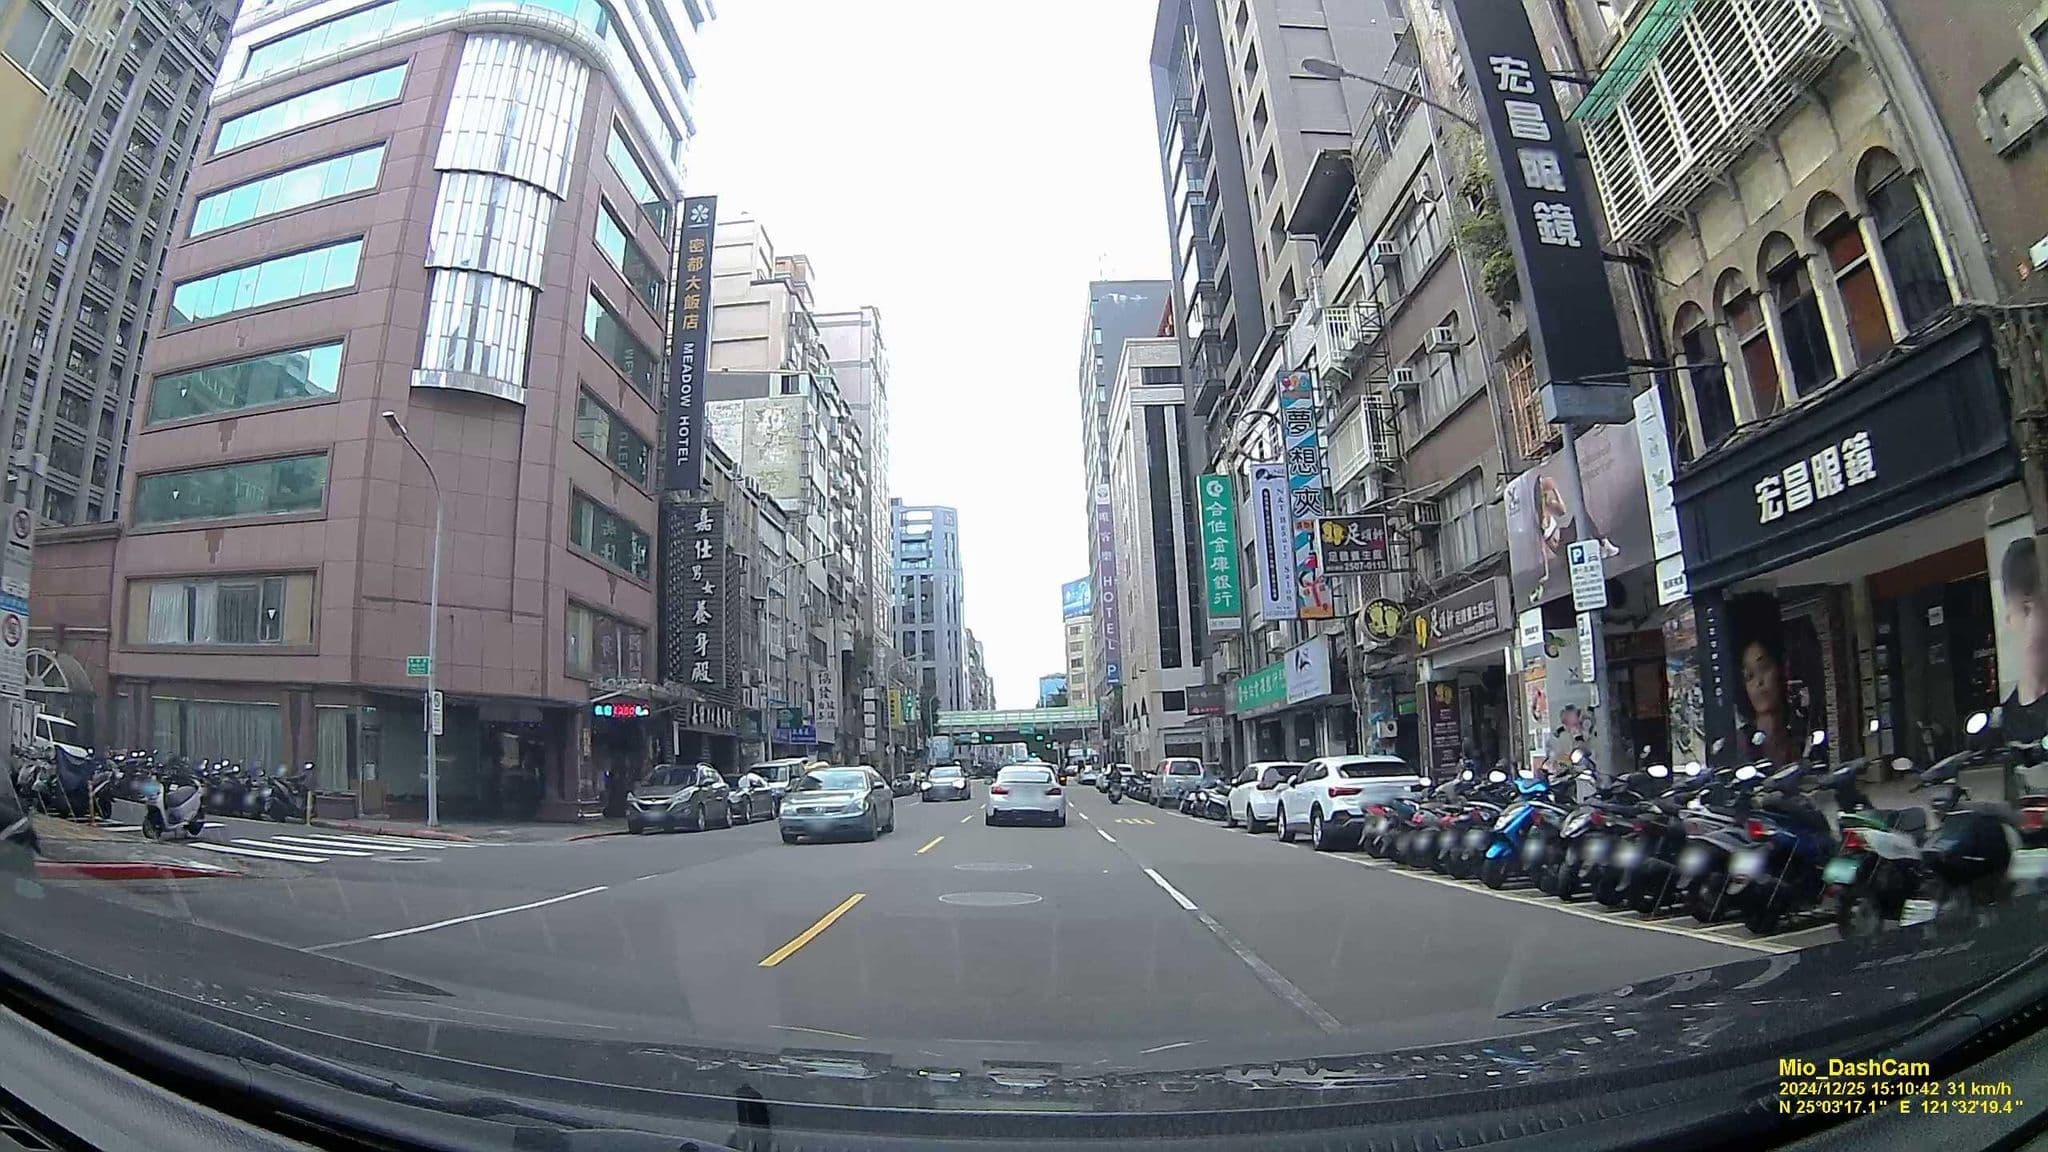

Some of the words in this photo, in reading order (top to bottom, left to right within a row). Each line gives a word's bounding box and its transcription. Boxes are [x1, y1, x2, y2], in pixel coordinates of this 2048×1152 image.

[1489, 55, 1583, 249] 宏昌眼鏡
[681, 238, 705, 331] 密都大飯店
[678, 342, 696, 408] MEADOW
[676, 416, 691, 467] HOTEL
[1285, 407, 1324, 519] 夢想夾
[1754, 430, 1878, 526] 宏昌眼鏡
[1205, 501, 1233, 608] 合作金庫銀行
[1571, 548, 1583, 563] P
[1103, 576, 1115, 650] HOTEL
[1107, 665, 1117, 677] P
